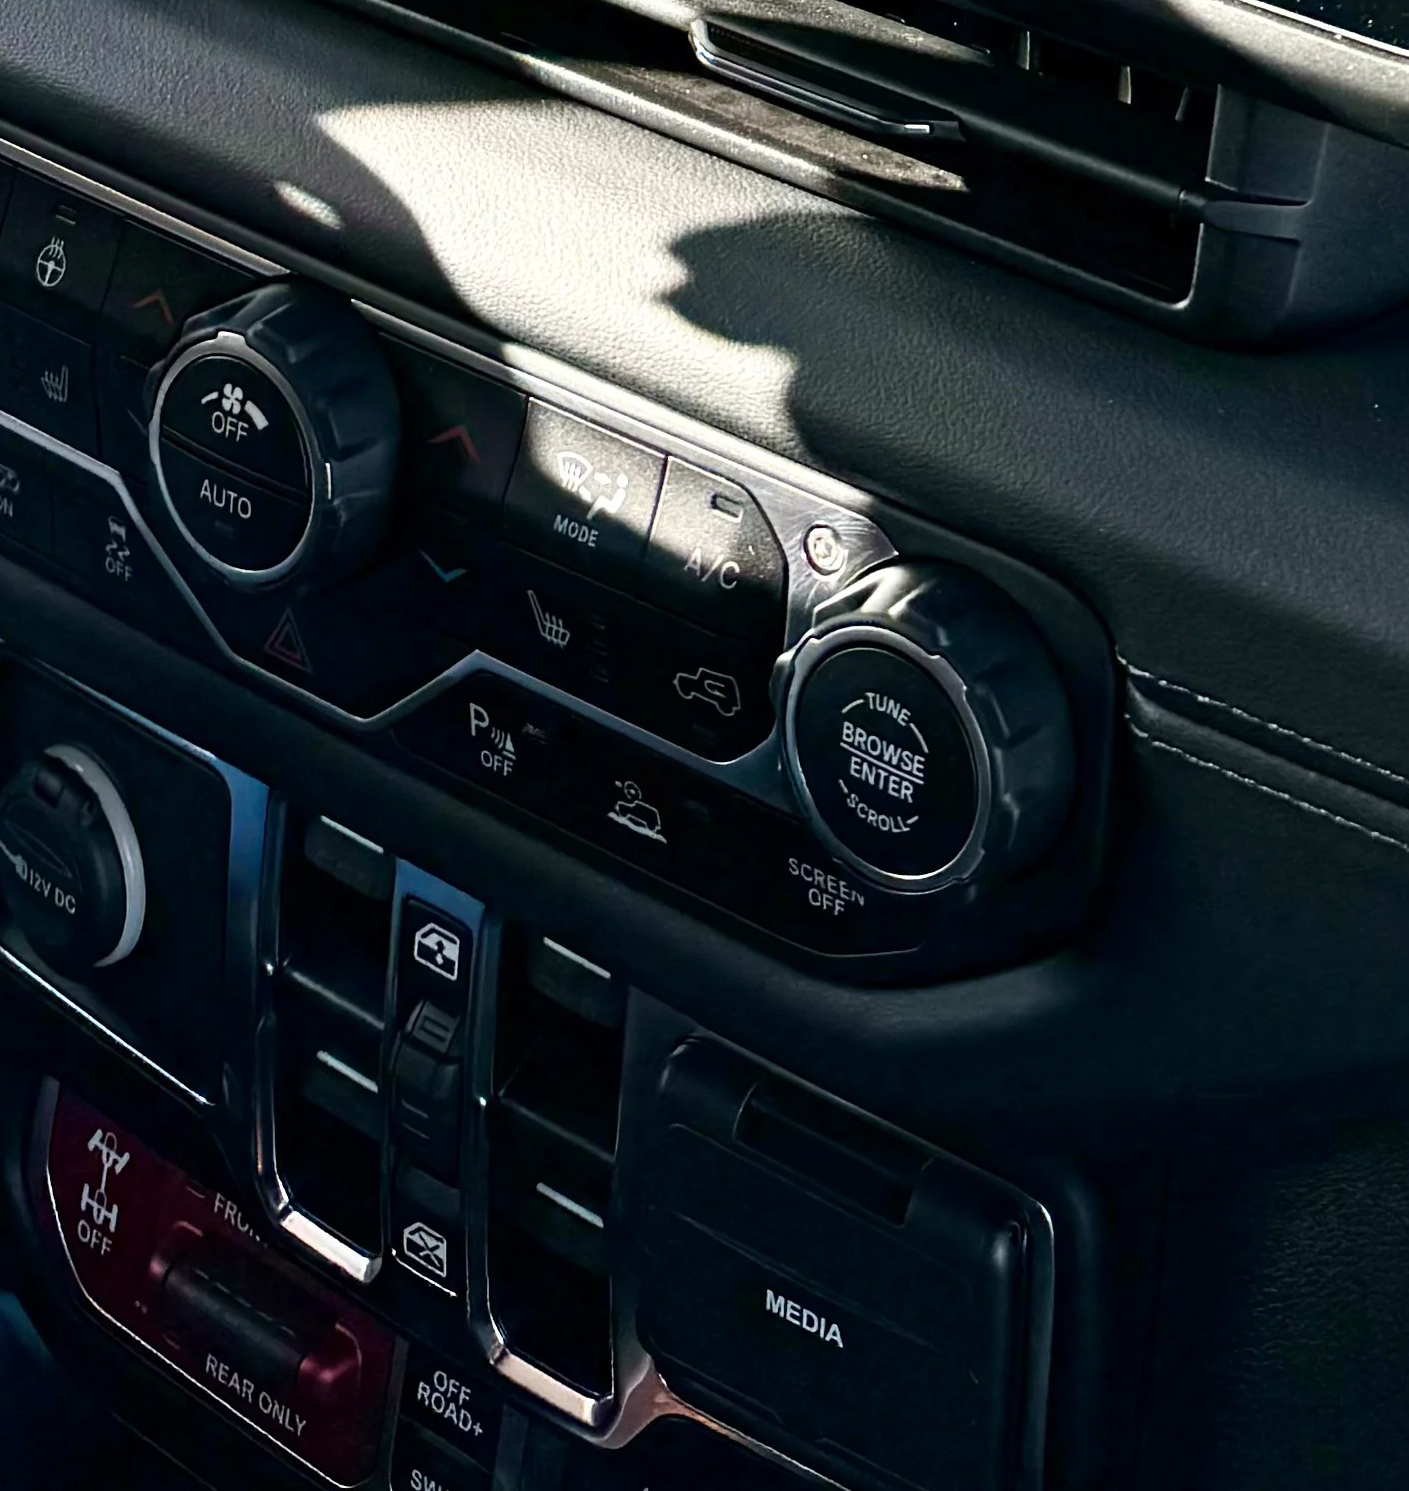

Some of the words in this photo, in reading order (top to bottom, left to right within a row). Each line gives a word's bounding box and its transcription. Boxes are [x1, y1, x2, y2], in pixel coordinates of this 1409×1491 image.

[210, 410, 250, 443] OFF
[199, 478, 253, 520] AUTO
[553, 514, 599, 548] MODE
[104, 555, 133, 582] OFF
[684, 546, 740, 590] A/C
[469, 701, 490, 737] P
[863, 691, 912, 727] TUNE
[480, 749, 514, 777] OFF
[841, 720, 926, 779] BROWSE
[849, 756, 914, 804] ENTER
[846, 792, 912, 833] SCROLL
[28, 868, 52, 899] 12V
[54, 886, 77, 915] DC
[787, 857, 866, 907] SCREEN
[807, 886, 846, 917] OFF
[76, 1220, 113, 1257] OFF
[765, 1288, 844, 1349] MEDIA
[204, 1352, 256, 1404] REAR
[258, 1392, 308, 1437] ONLY
[433, 1369, 472, 1406] OFF
[416, 1380, 484, 1437] ROAD+
